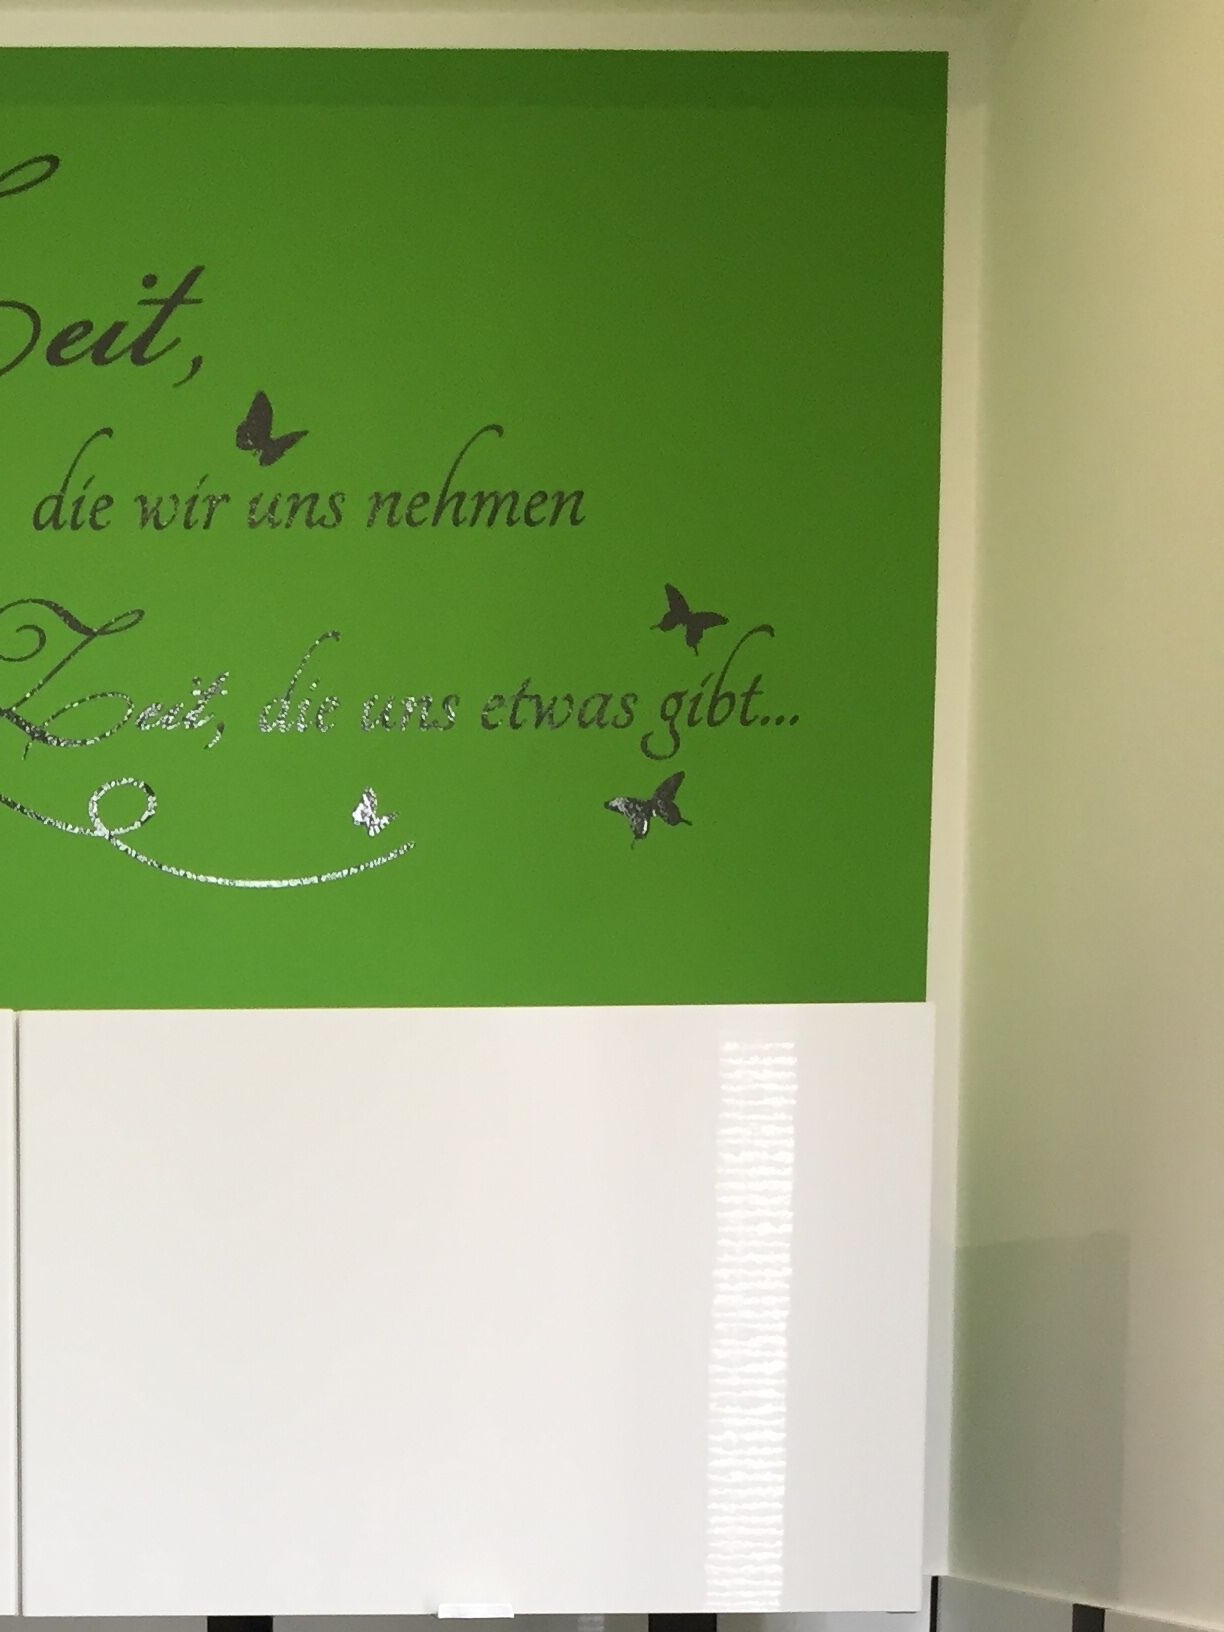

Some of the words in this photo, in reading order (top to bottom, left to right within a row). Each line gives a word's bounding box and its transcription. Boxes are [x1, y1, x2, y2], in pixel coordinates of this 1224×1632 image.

[32, 427, 114, 532] die
[133, 474, 230, 531] wir
[246, 490, 345, 531] uns
[367, 424, 586, 528] nehmen
[258, 630, 341, 733] die
[359, 694, 461, 733] uns
[481, 677, 638, 730] etwas
[640, 624, 799, 760] gibt...
